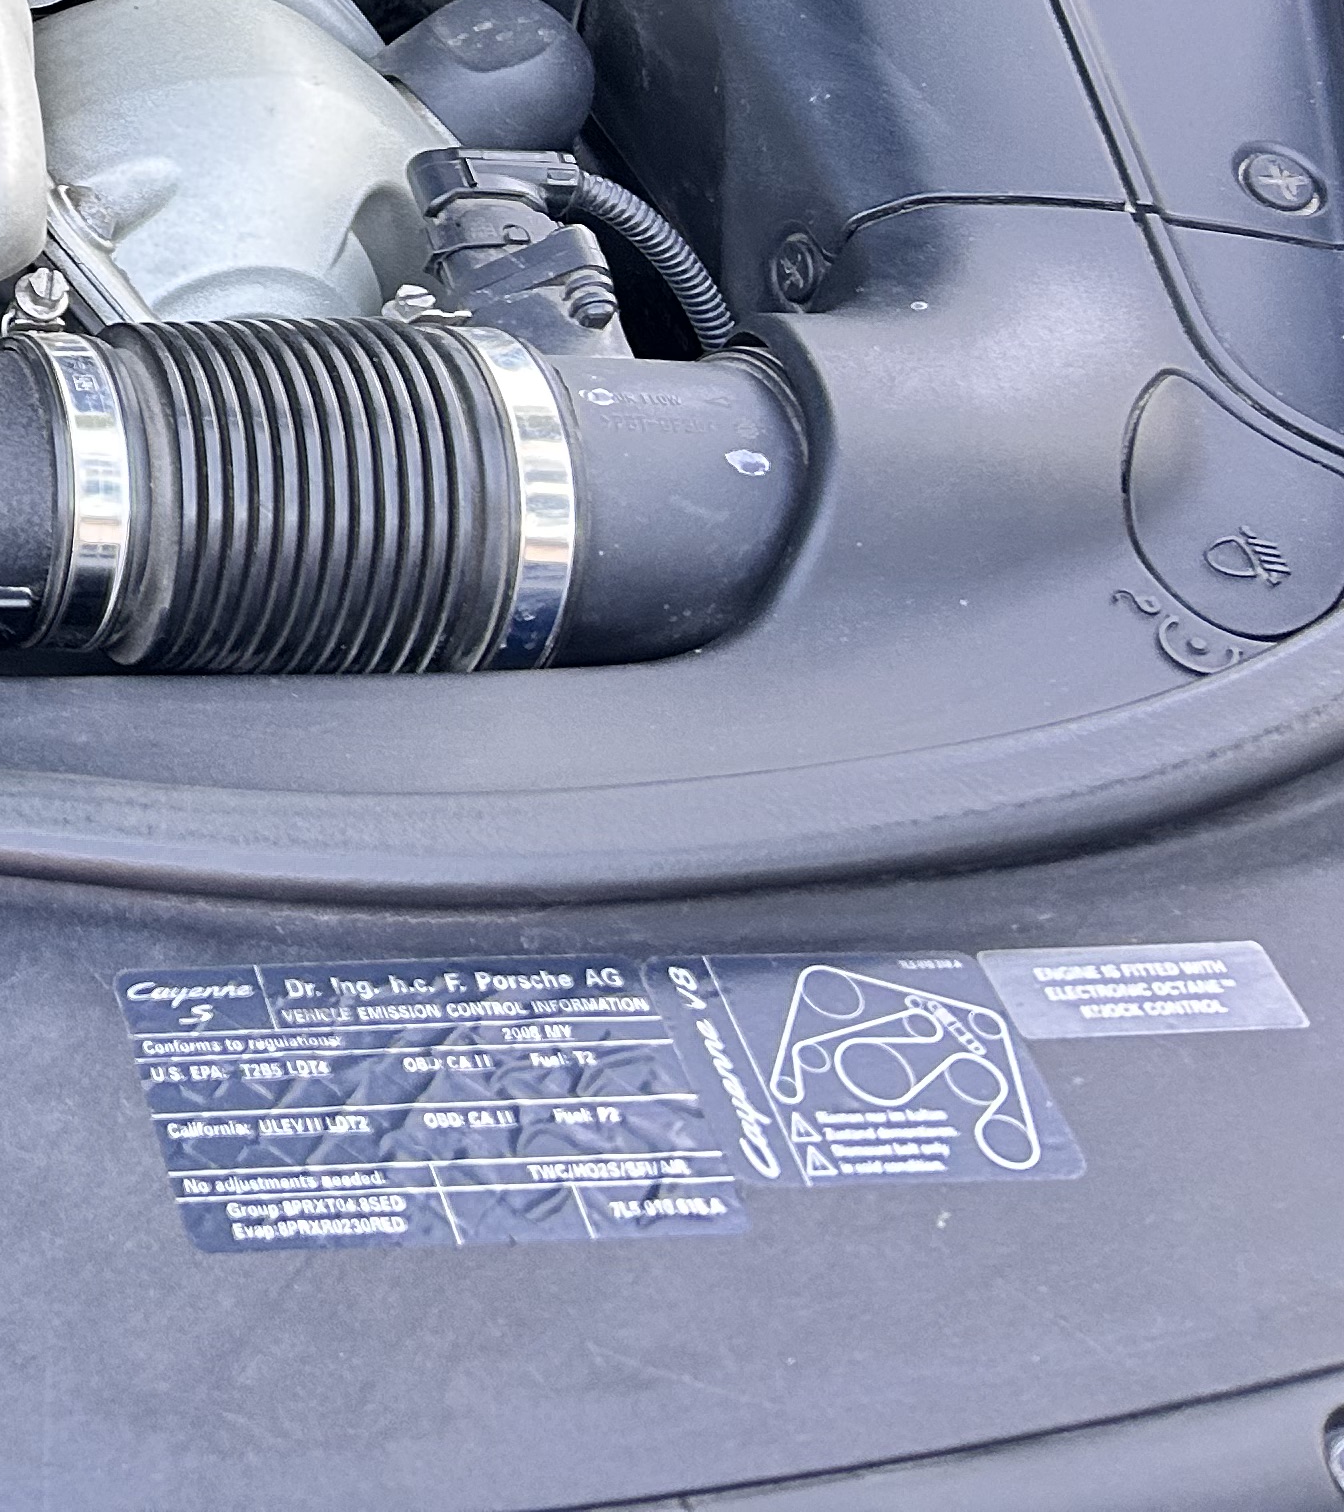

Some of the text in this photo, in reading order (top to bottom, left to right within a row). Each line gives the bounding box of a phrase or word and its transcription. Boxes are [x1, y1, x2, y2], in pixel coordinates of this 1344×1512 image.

[126, 981, 255, 1009] Cayenne
[284, 967, 625, 1000] Dr. Ing. h.c. F. Porsche AG
[178, 1004, 214, 1026] S
[281, 996, 651, 1025] VEHICLE EMISSION CONTROL INFORMATION
[142, 1039, 223, 1055] Conforms
[223, 1037, 244, 1052] to
[446, 1054, 473, 1069] CA
[572, 1050, 598, 1067] T2
[695, 1018, 782, 1180] Cayenne
[258, 1118, 304, 1134] ULEV
[183, 1170, 387, 1195] No adjustments needed.
